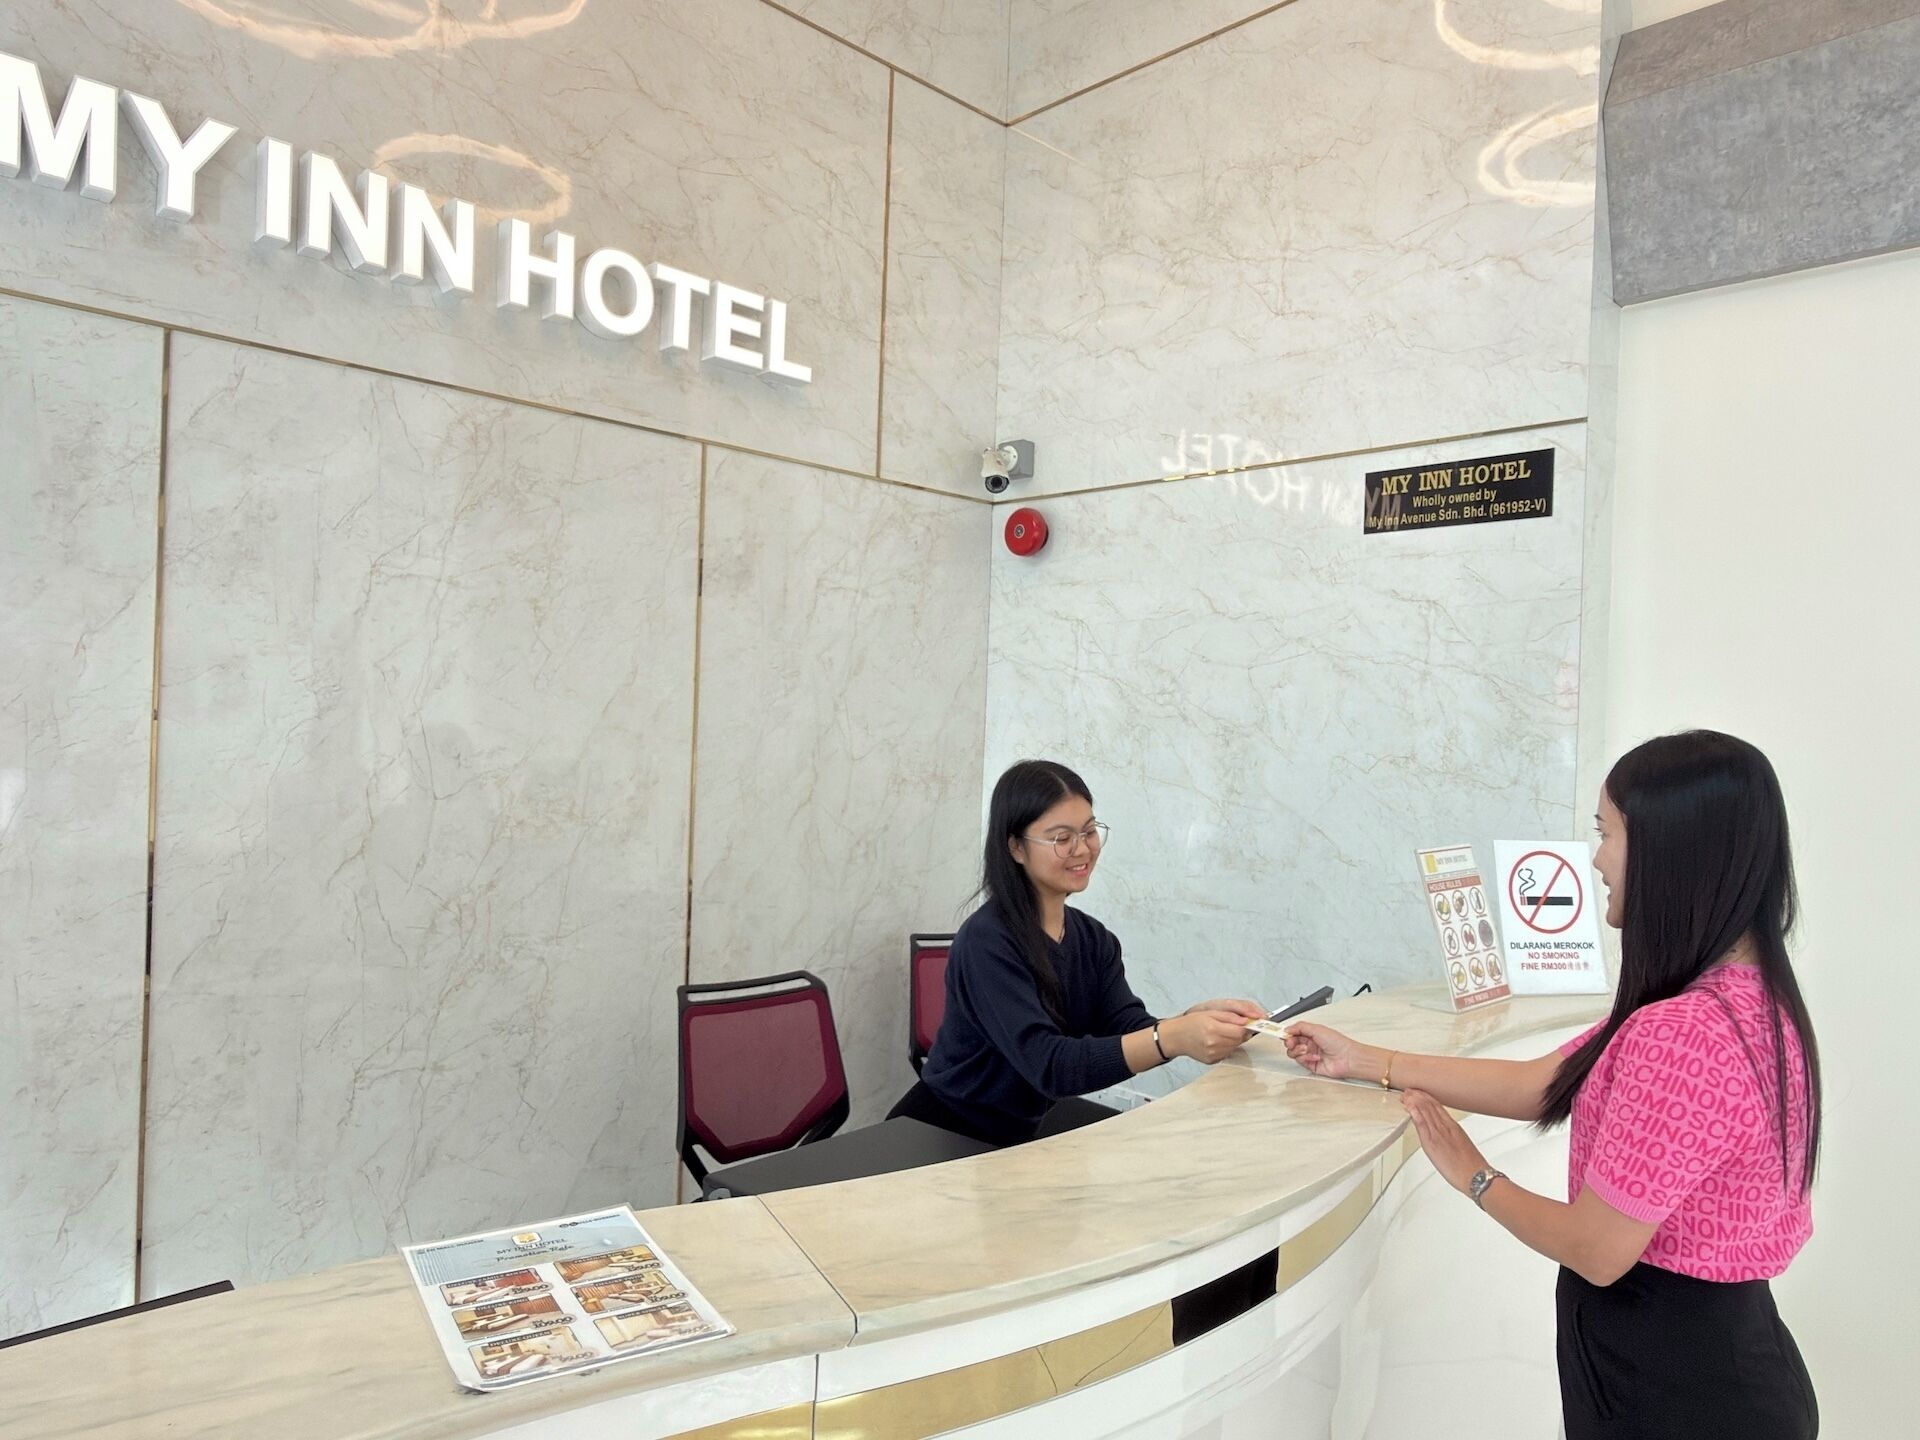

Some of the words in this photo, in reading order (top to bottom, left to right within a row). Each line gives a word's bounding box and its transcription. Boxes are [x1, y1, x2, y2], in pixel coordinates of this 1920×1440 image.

[0, 52, 238, 222] MY
[257, 137, 475, 298] INN
[498, 219, 812, 386] HOTEL
[1381, 473, 1413, 496] MY
[1418, 469, 1453, 491] INN
[1459, 459, 1532, 486] HOTEL
[1412, 492, 1446, 509] Wholly
[1448, 490, 1482, 504] owned
[1483, 488, 1497, 501] by
[1369, 515, 1382, 530] My
[1384, 514, 1399, 525] Inn
[1400, 510, 1437, 525] Avenue
[1438, 507, 1461, 520] Sdn.
[1464, 505, 1487, 518] Bhd.
[1489, 498, 1547, 518] (961952-V)
[1510, 941, 1552, 950] DILARANG
[1553, 941, 1595, 950] MEROKOK
[1528, 951, 1540, 960] NO
[1542, 951, 1580, 960] SMOKING
[1521, 962, 1539, 970] FINE
[1541, 962, 1567, 970] RM300
